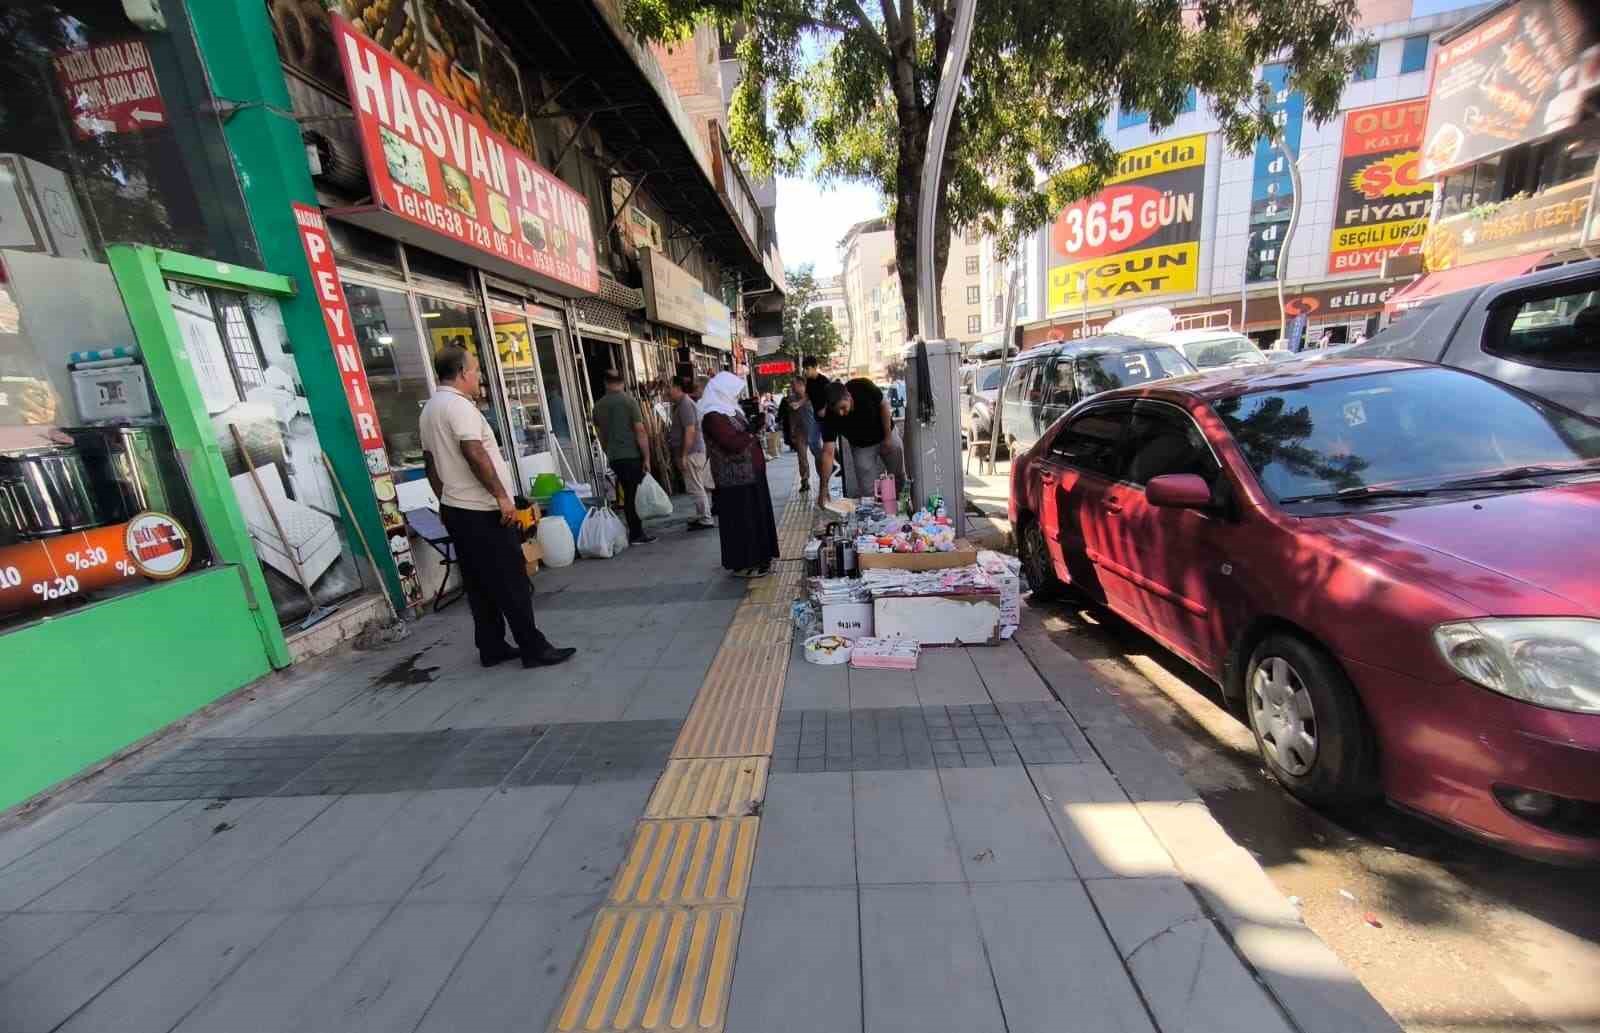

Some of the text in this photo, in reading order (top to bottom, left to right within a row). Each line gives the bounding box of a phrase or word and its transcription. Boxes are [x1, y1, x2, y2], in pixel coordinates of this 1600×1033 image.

[344, 32, 510, 197] HASVAN
[1065, 190, 1195, 254] 365 GÜN
[1339, 228, 1385, 247] SEÇİLİ
[65, 547, 108, 570] %30
[32, 575, 79, 601] %20
